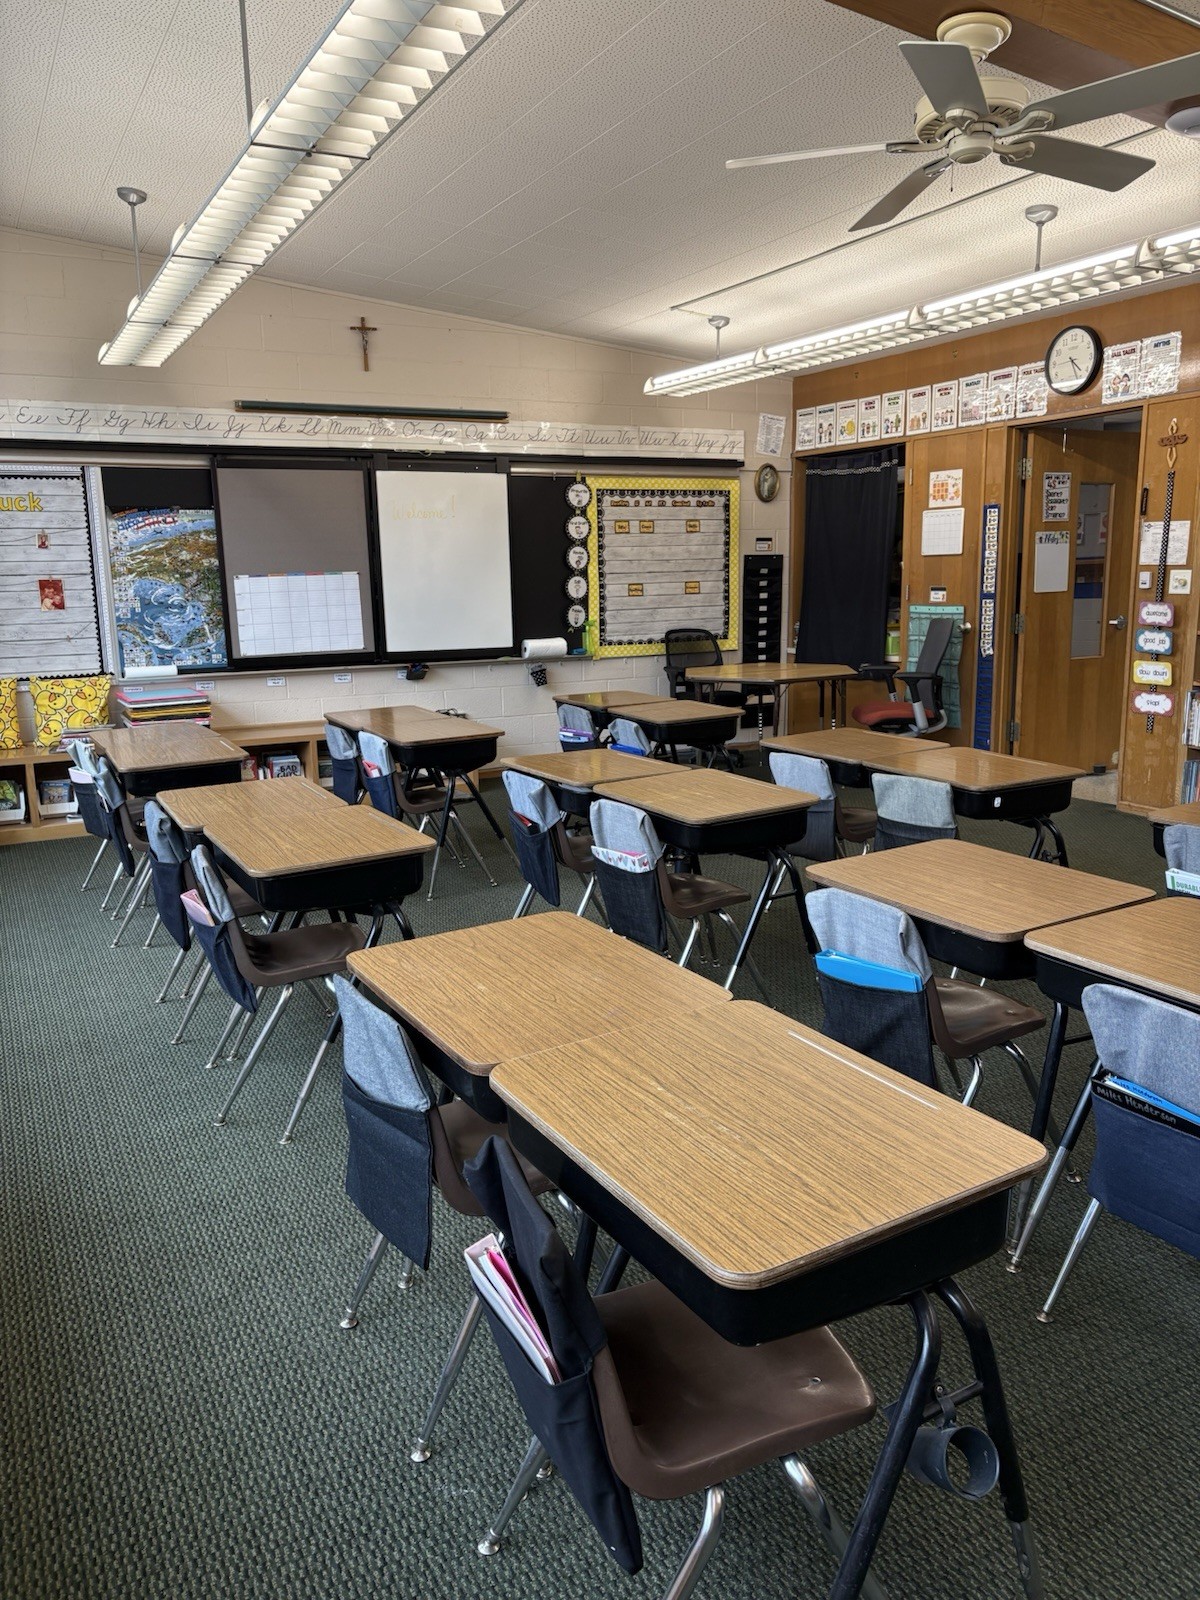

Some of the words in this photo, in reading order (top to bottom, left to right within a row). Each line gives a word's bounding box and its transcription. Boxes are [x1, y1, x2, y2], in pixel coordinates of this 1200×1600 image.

[1070, 333, 1078, 342] 12
[1062, 338, 1068, 347] 11
[16, 406, 49, 424] Ee
[56, 408, 92, 434] Ff
[102, 410, 136, 436] Gg
[141, 411, 177, 430] Hh
[182, 414, 219, 431] Ii
[222, 414, 252, 438] Jj
[258, 416, 294, 434] Kk
[296, 417, 325, 436] Ll
[327, 418, 366, 436] Mm
[367, 420, 395, 436] Nn
[402, 421, 424, 437] Oo
[430, 422, 457, 445] Pp
[464, 424, 490, 442] Qq
[492, 424, 522, 442] Rr
[528, 427, 553, 442] Ss
[556, 428, 582, 443] Tt
[584, 430, 617, 445] Uu
[617, 430, 638, 445] Vv
[640, 430, 669, 446] Ww
[669, 432, 692, 447] Xx
[694, 432, 720, 454] Yy
[720, 434, 742, 454] Zz
[1143, 636, 1156, 645] good
[1157, 637, 1166, 646] job
[280, 765, 297, 773] BAD
[1096, 1086, 1122, 1102] Miles
[1124, 1094, 1177, 1125] Henderson
